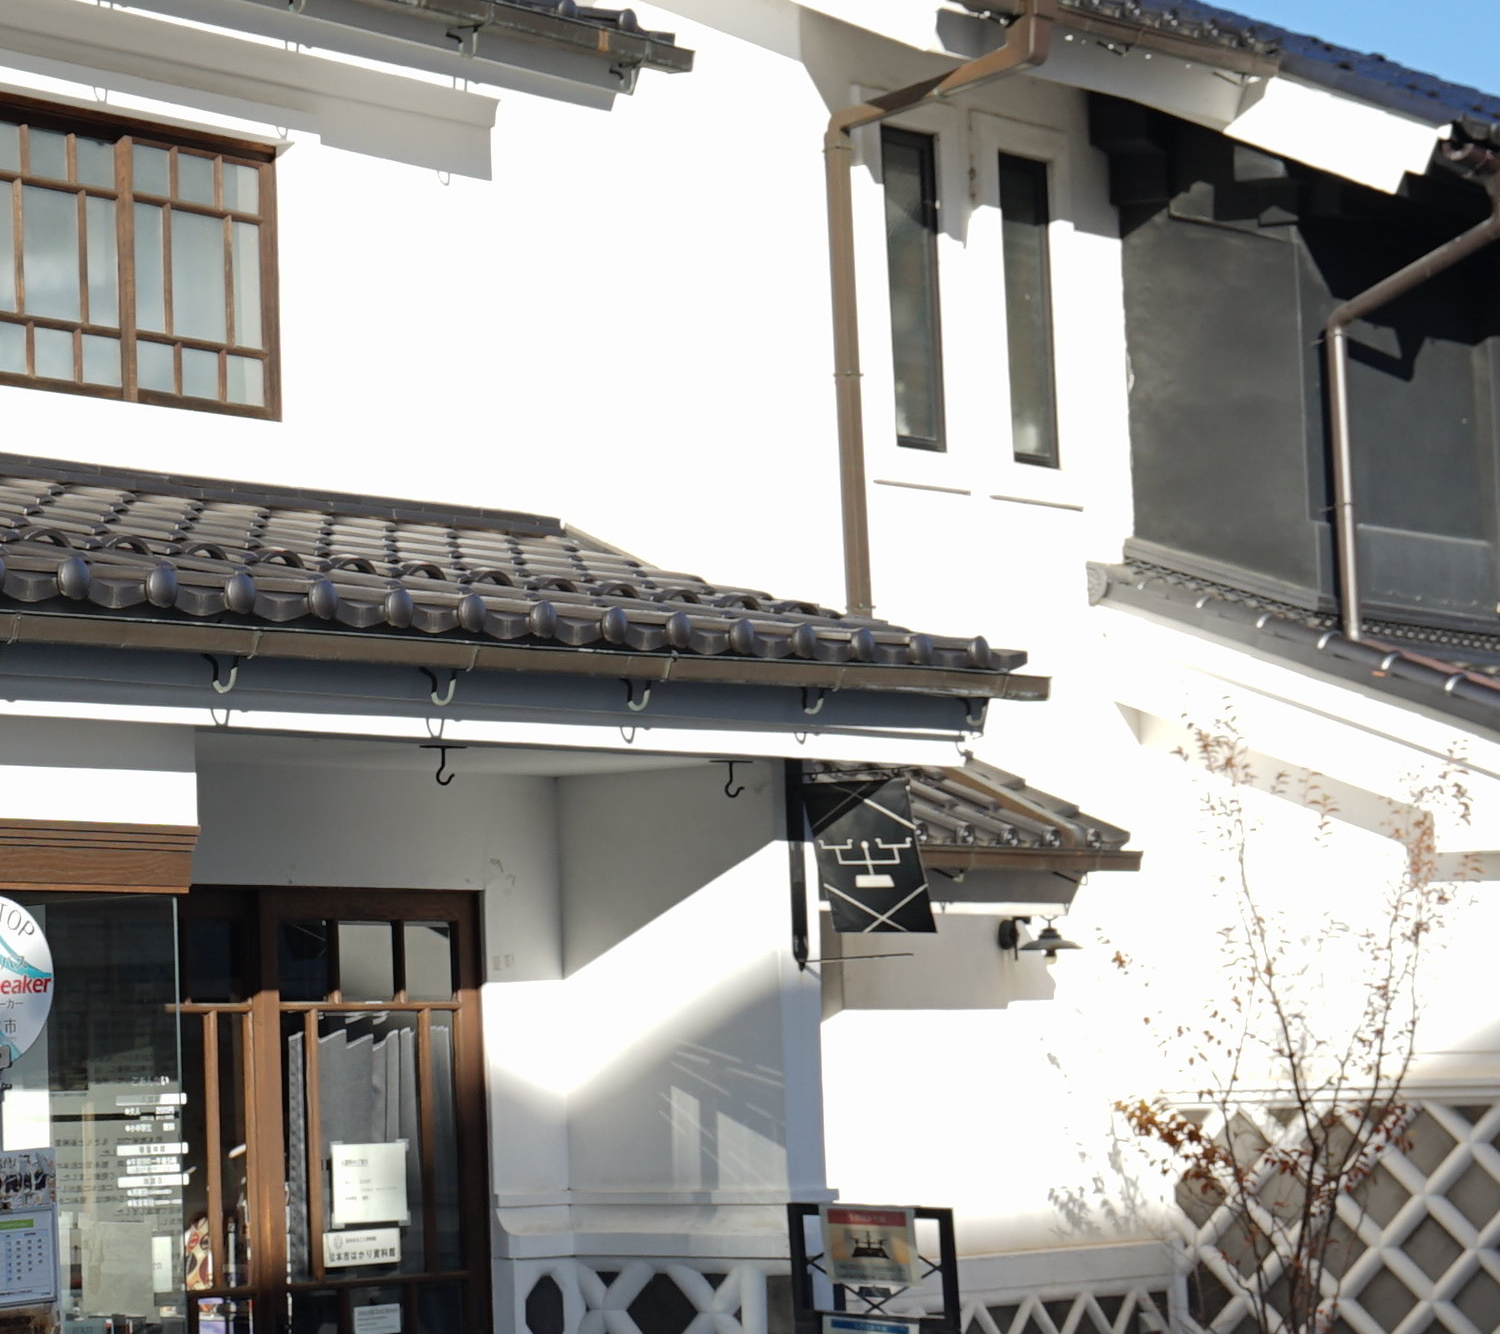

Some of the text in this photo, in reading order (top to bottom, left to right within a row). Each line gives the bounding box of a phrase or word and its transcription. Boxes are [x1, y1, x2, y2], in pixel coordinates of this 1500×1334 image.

[329, 1248, 396, 1262] 松本市はかり資料館
